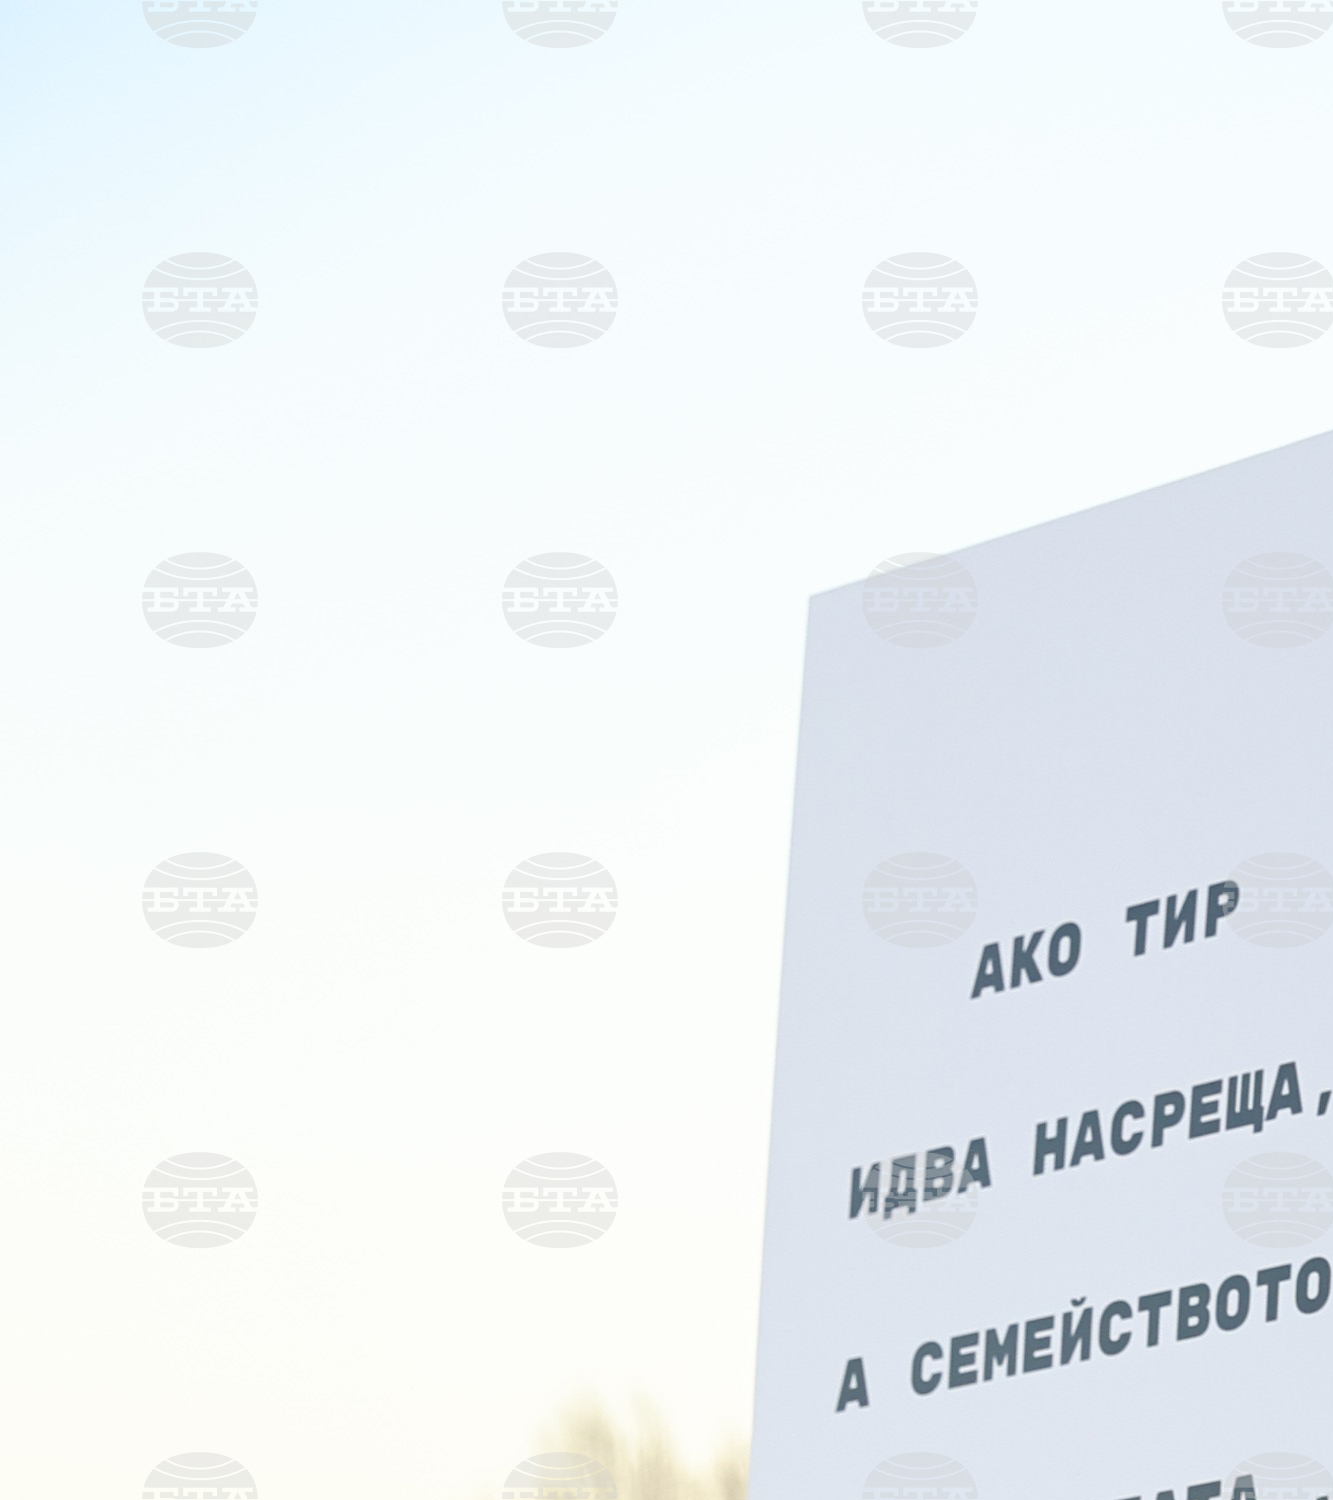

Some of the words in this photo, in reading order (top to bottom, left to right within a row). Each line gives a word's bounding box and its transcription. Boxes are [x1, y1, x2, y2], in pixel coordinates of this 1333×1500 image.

[971, 922, 1081, 999] АКО
[1126, 881, 1239, 956] ТИР
[849, 1137, 991, 1219] ИДВА
[1033, 1062, 1331, 1175] НАСРЕЩА,
[836, 1357, 869, 1412] А
[912, 1257, 1331, 1395] СЕМЕЙСТВОТО
